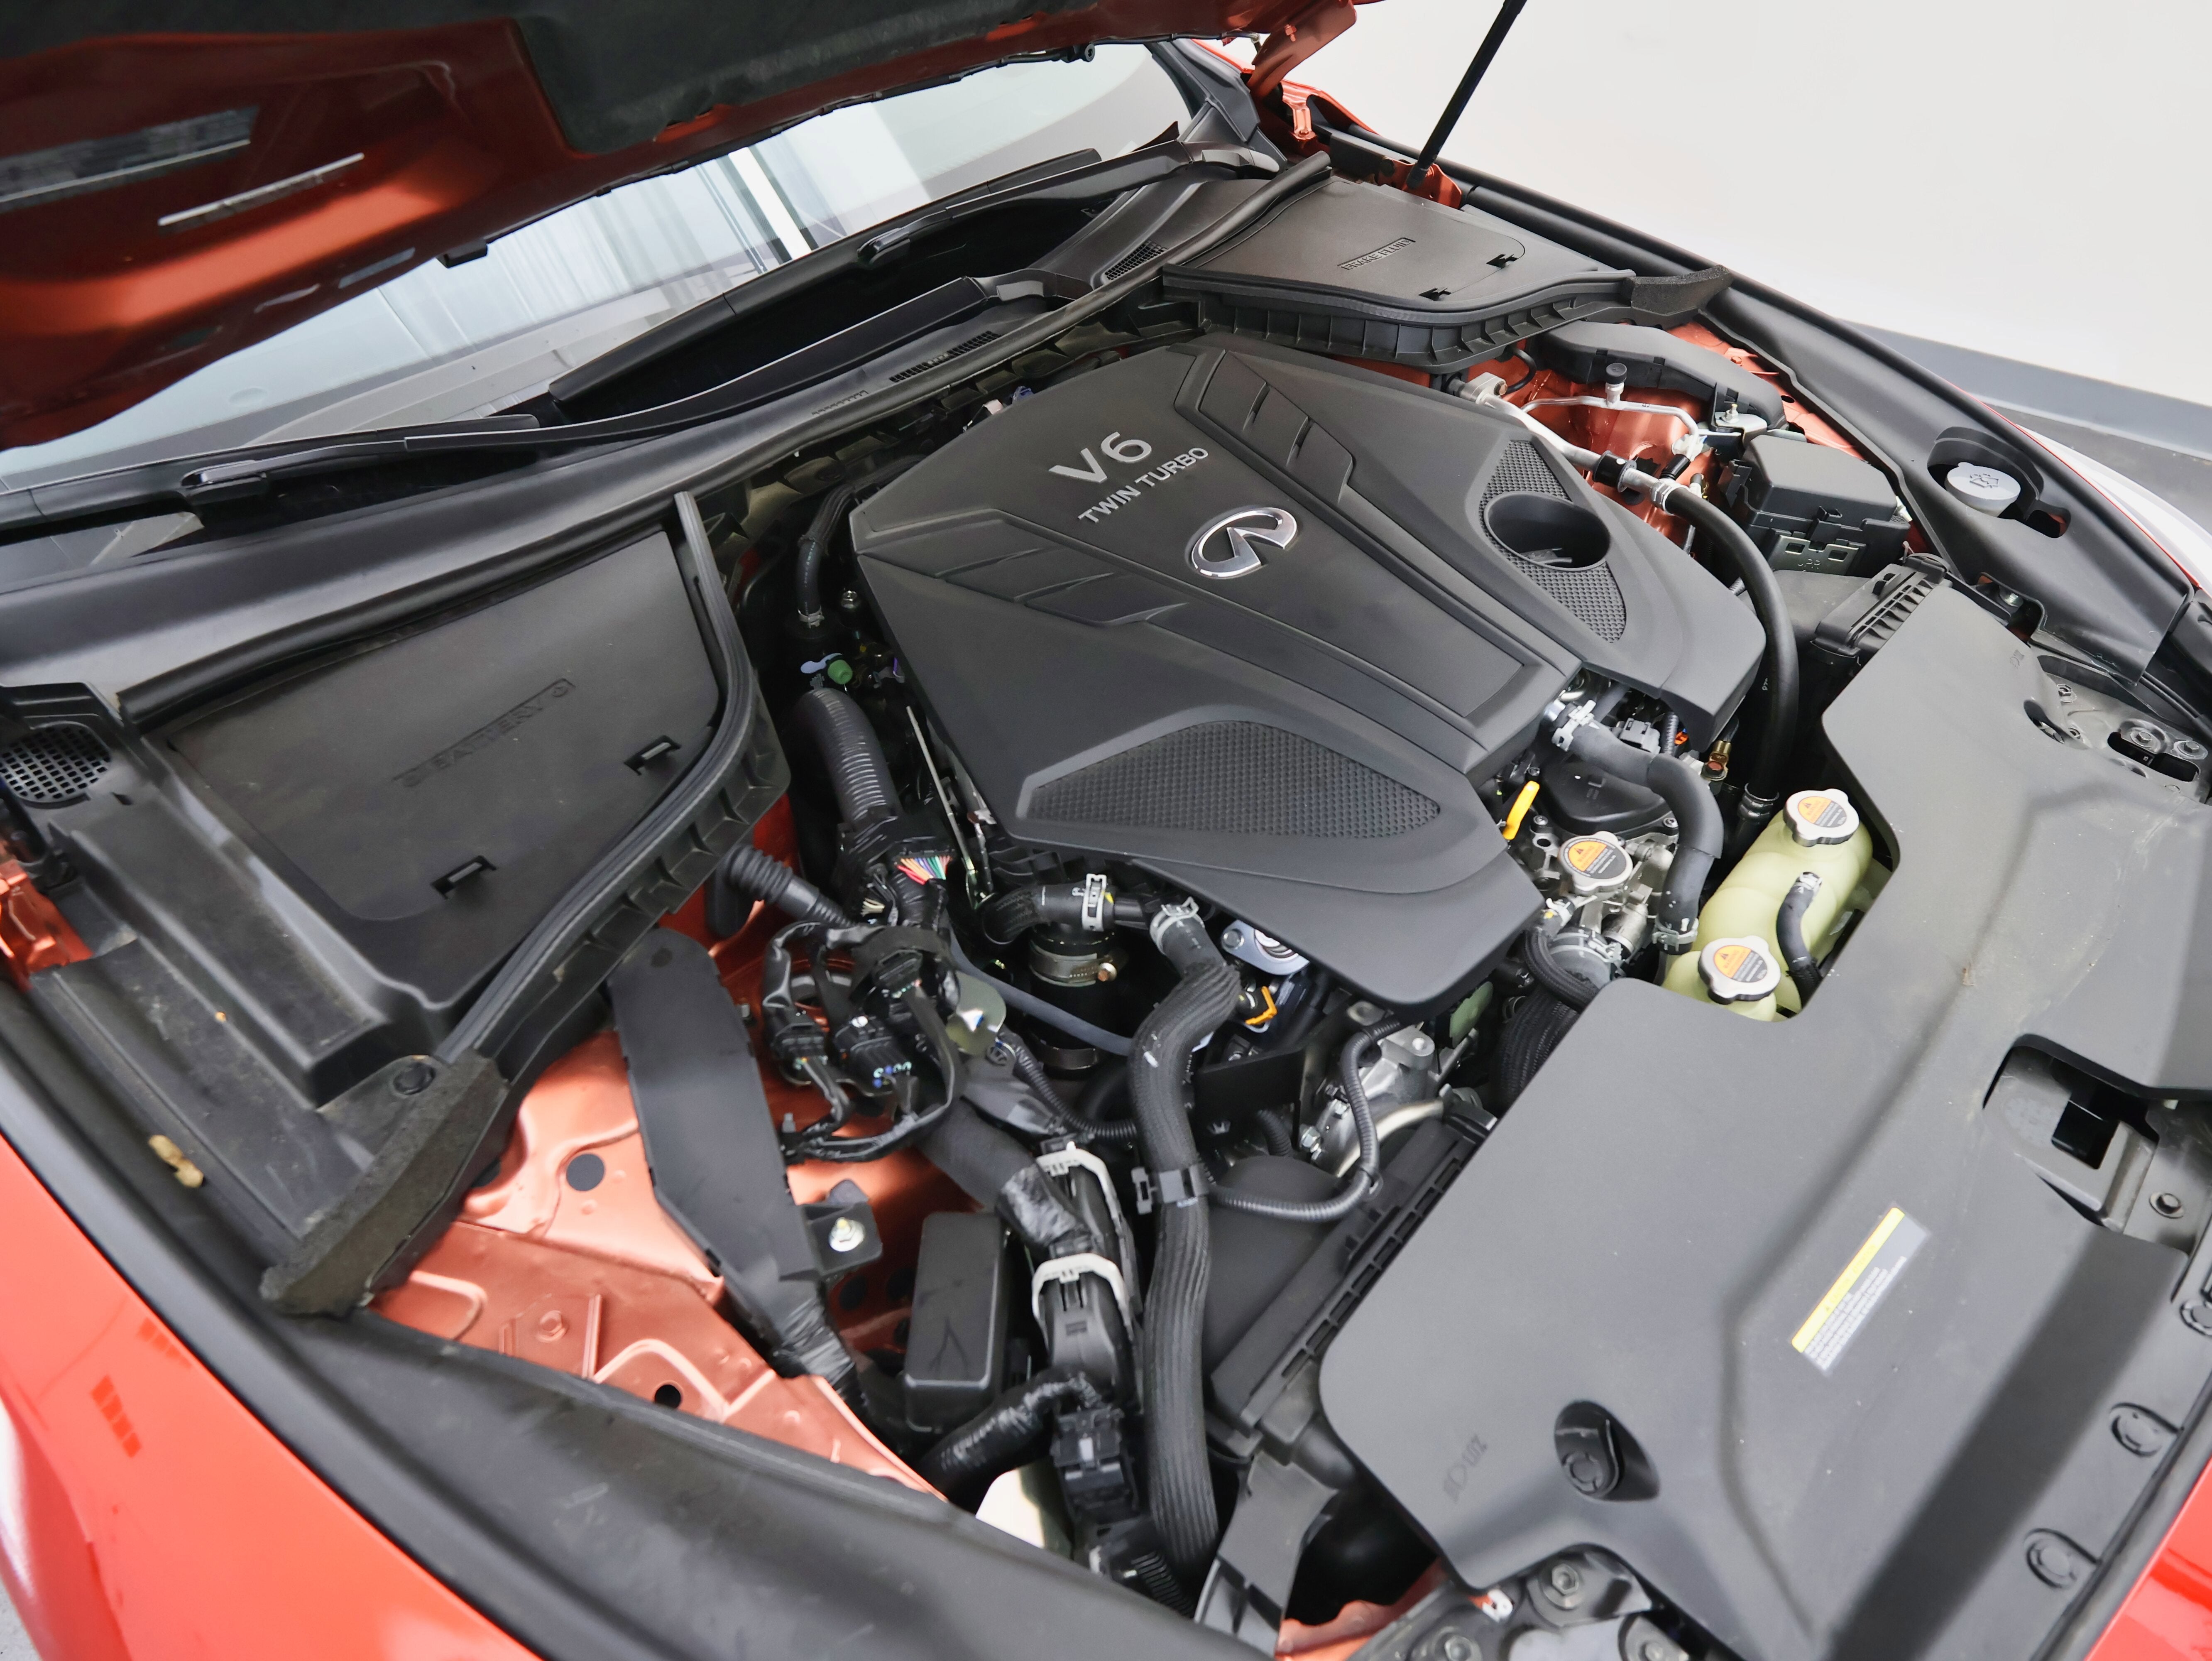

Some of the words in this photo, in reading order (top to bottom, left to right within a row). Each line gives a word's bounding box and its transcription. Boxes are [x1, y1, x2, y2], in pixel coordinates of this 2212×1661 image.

[1341, 254, 1382, 270] BRAKE
[1378, 239, 1411, 255] FLUID
[1048, 431, 1152, 483] V6
[1077, 485, 1141, 523] TWIN
[1134, 447, 1209, 487] TURBO
